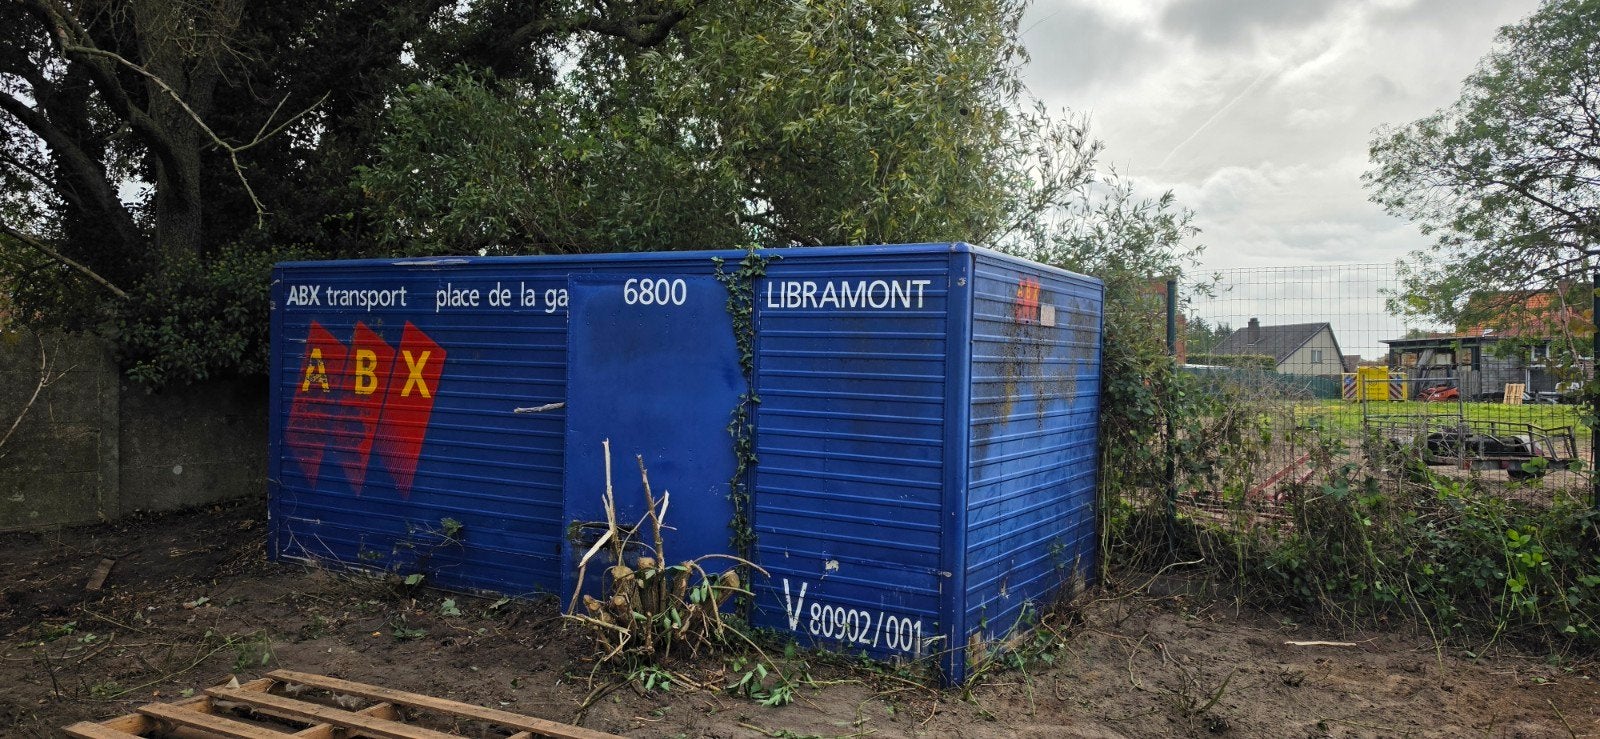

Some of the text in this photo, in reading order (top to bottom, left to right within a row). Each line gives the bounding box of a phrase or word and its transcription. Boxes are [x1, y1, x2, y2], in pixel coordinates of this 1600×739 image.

[286, 285, 321, 306] ABX
[326, 286, 408, 312] transport
[435, 282, 480, 313] place
[488, 281, 512, 307] de
[520, 281, 536, 307] la
[623, 278, 687, 306] 6800
[766, 279, 931, 309] LIBRAMONT
[301, 348, 431, 398] ABX
[783, 578, 922, 654] V 80902/001
